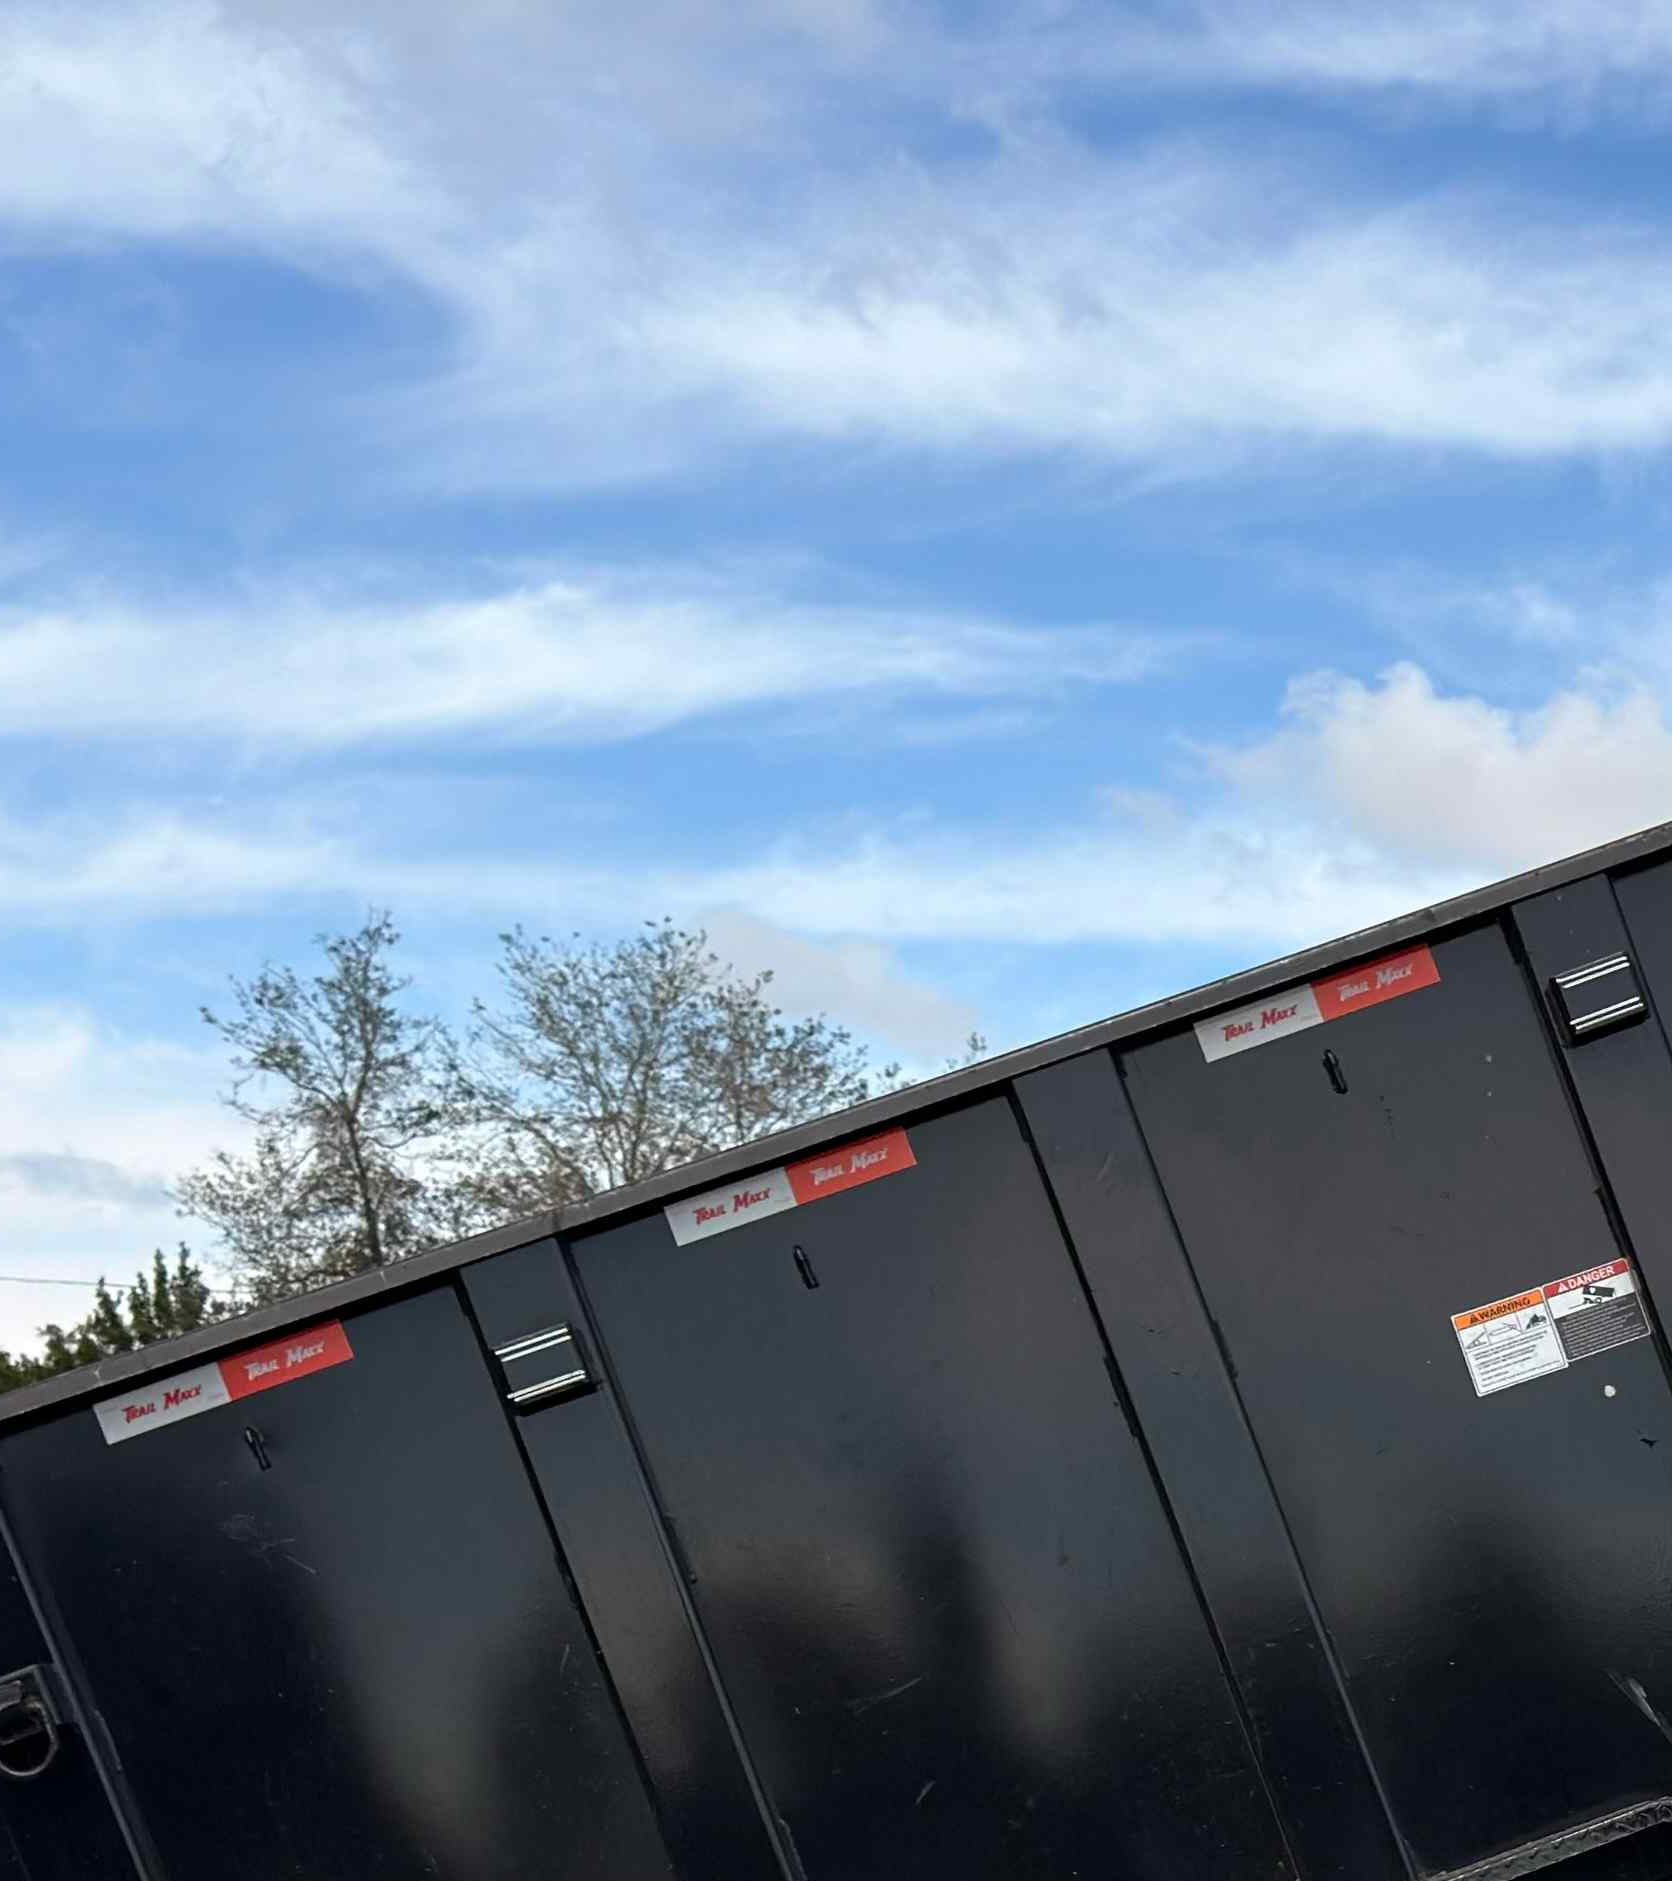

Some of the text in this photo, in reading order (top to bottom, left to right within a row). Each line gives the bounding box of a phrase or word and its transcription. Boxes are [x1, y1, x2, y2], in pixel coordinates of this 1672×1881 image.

[1337, 963, 1413, 1001] TRAIL MAXX
[1220, 1004, 1298, 1042] TRAIL MAXX
[810, 1147, 889, 1186] TRAIL MAXX
[693, 1187, 771, 1225] TRAIL MAXX
[1568, 1265, 1616, 1289] DANGER
[1479, 1296, 1531, 1322] WARNING
[244, 1341, 327, 1380] TRAIL MAXX
[122, 1384, 202, 1423] TRAIL MAXX
